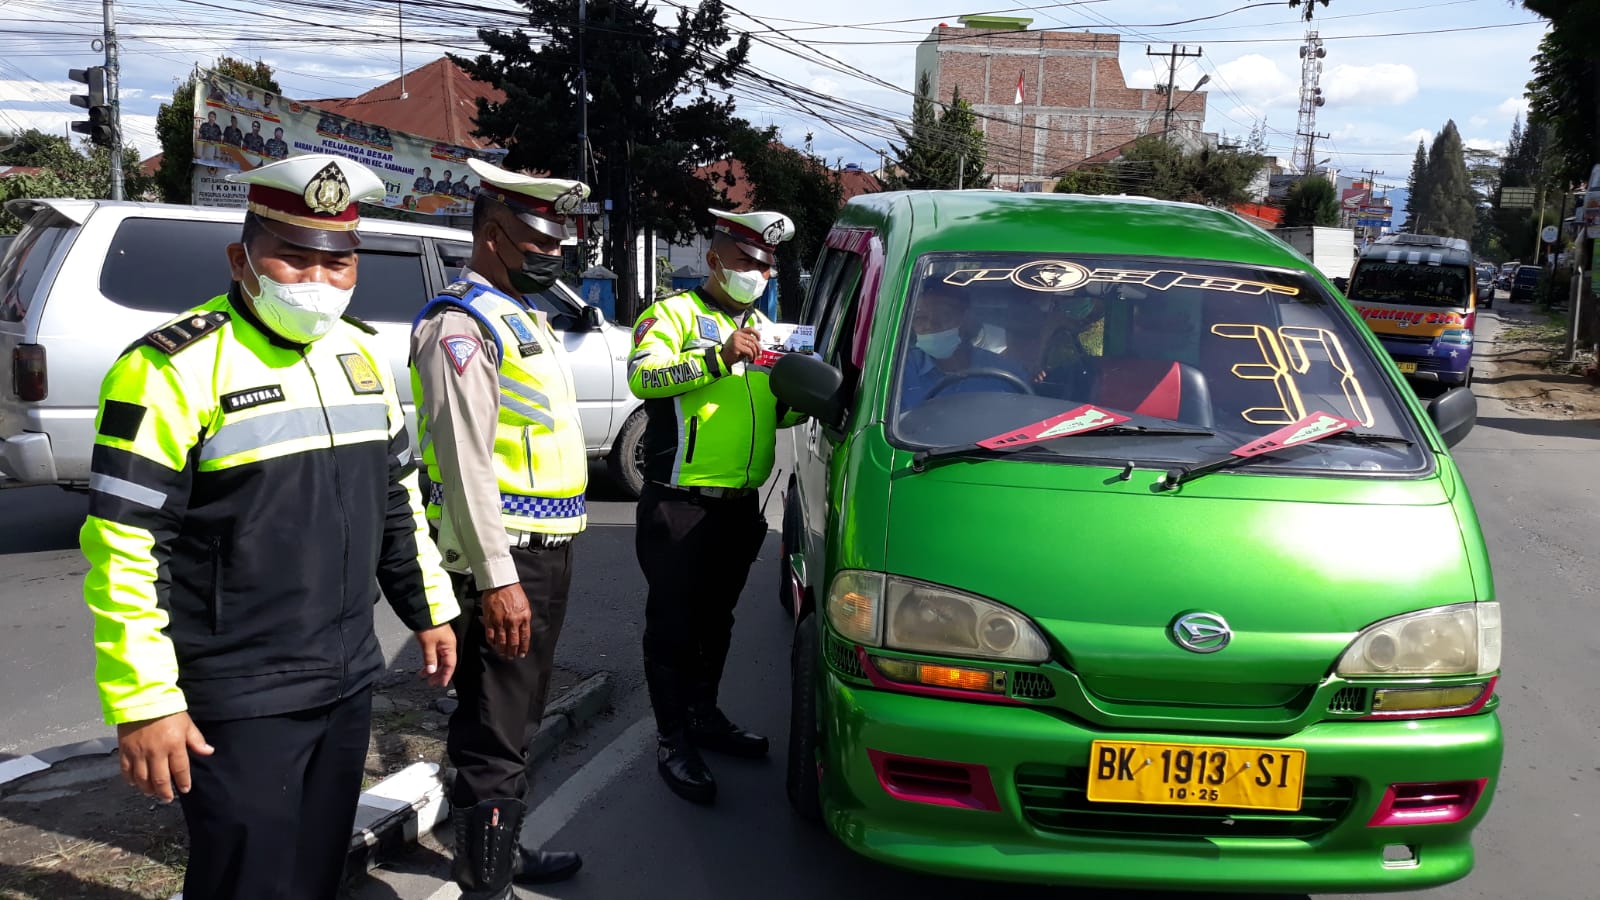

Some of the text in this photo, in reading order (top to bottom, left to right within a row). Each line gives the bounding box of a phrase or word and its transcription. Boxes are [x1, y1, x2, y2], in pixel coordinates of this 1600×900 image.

[322, 140, 393, 161] KELUARGA BESAR
[385, 162, 414, 175] KABANJAHE
[642, 359, 705, 388] PATWAL
[1098, 746, 1291, 788] BK 1913 SI
